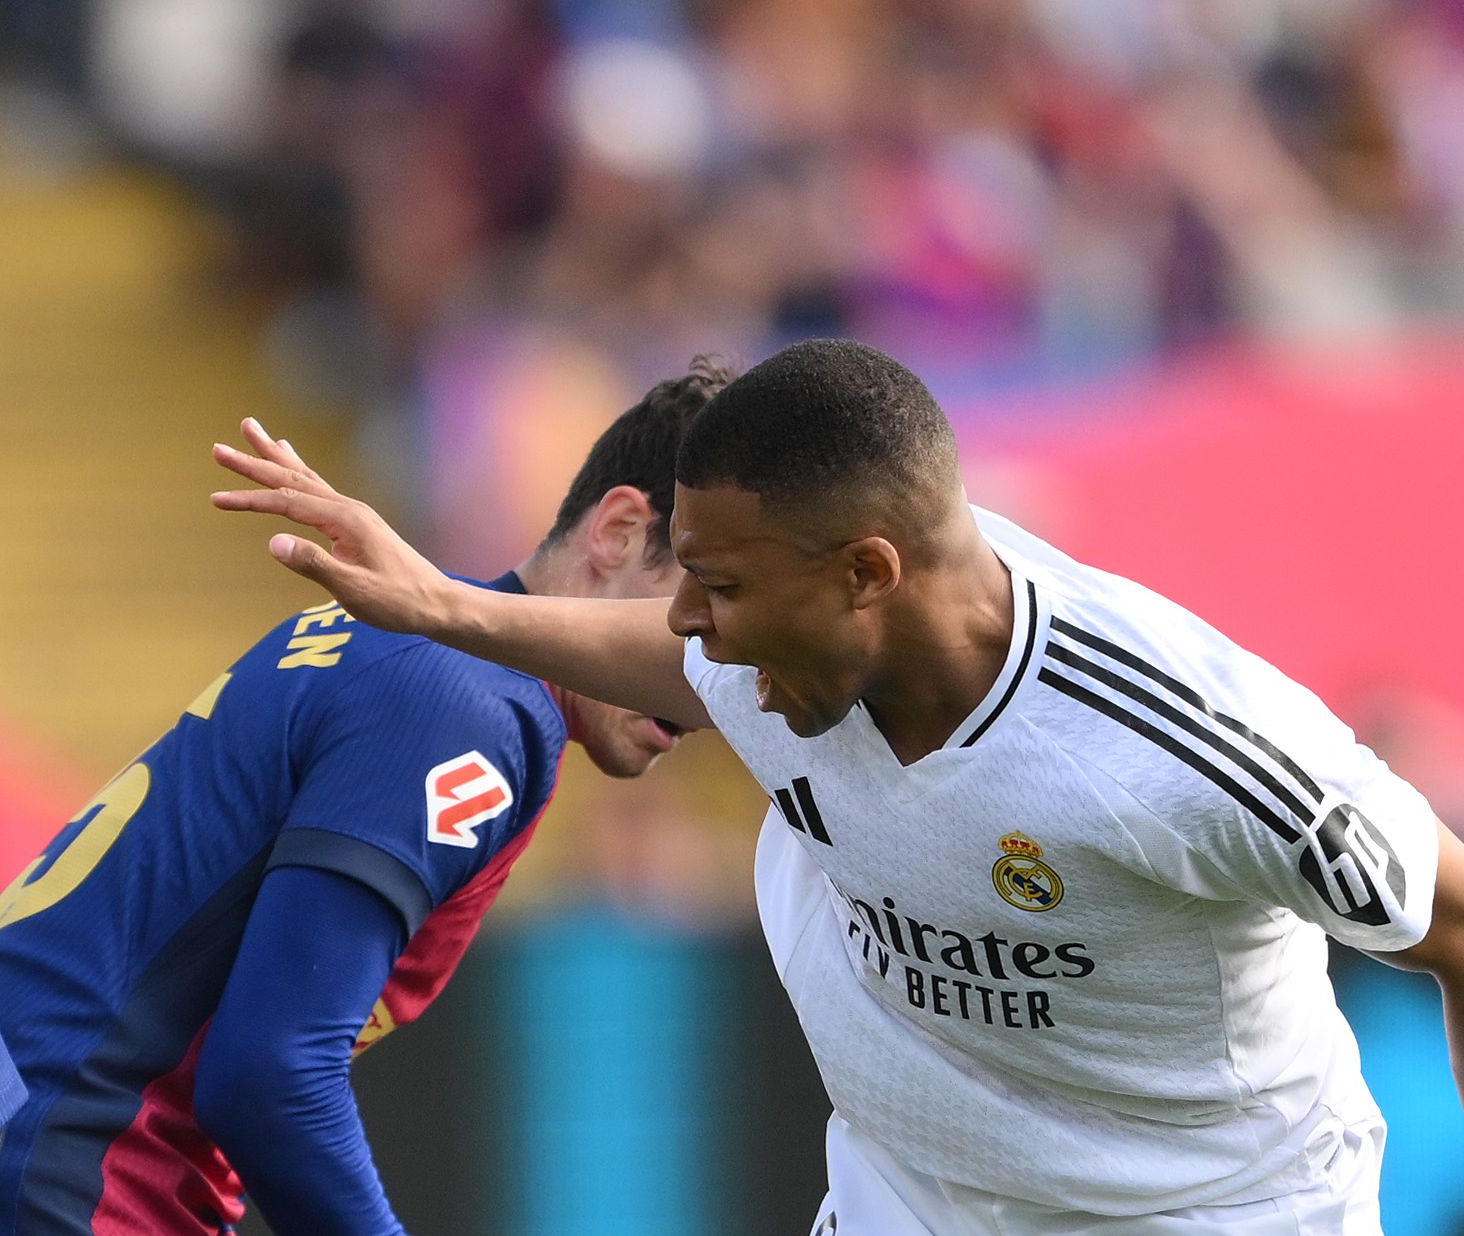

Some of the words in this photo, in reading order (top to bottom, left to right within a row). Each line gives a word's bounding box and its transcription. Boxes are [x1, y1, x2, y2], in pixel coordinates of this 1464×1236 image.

[277, 599, 356, 669] EN
[846, 895, 1095, 980] irates
[905, 966, 1055, 1029] BETTER
